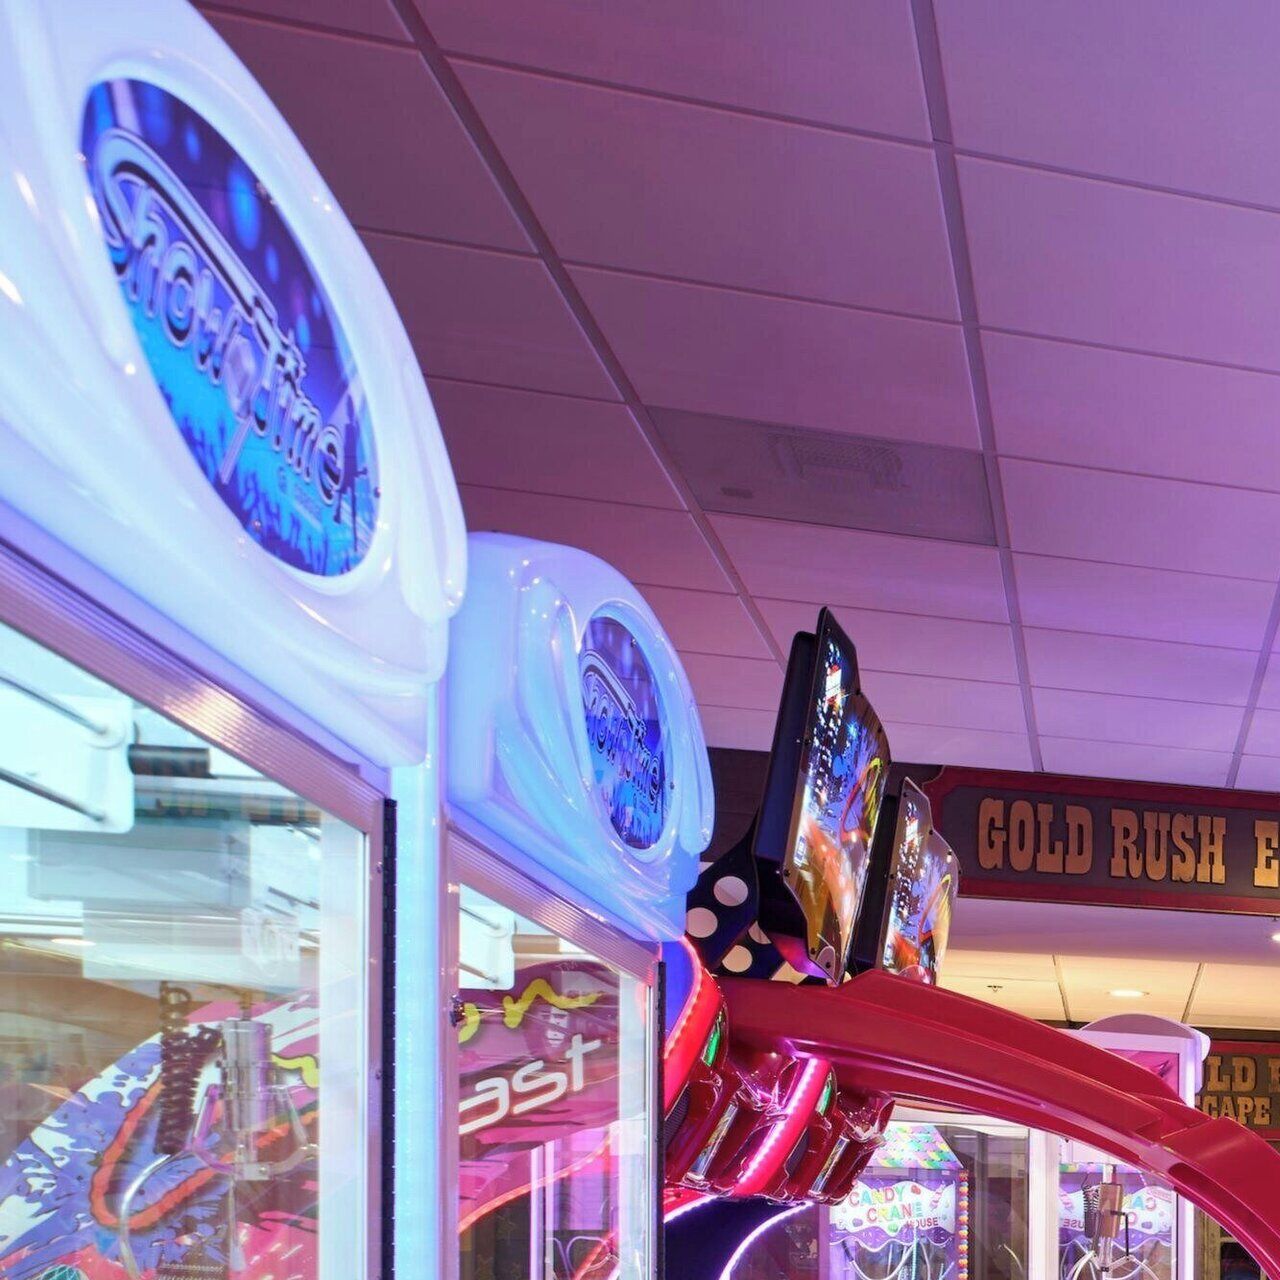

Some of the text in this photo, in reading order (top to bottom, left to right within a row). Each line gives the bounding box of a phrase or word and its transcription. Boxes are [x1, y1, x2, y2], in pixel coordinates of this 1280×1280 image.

[978, 797, 1094, 875] GOLD
[1110, 808, 1226, 885] RUSH
[1206, 1056, 1257, 1093] LD
[1196, 1095, 1270, 1126] CAPE
[849, 1184, 907, 1207] CANDY
